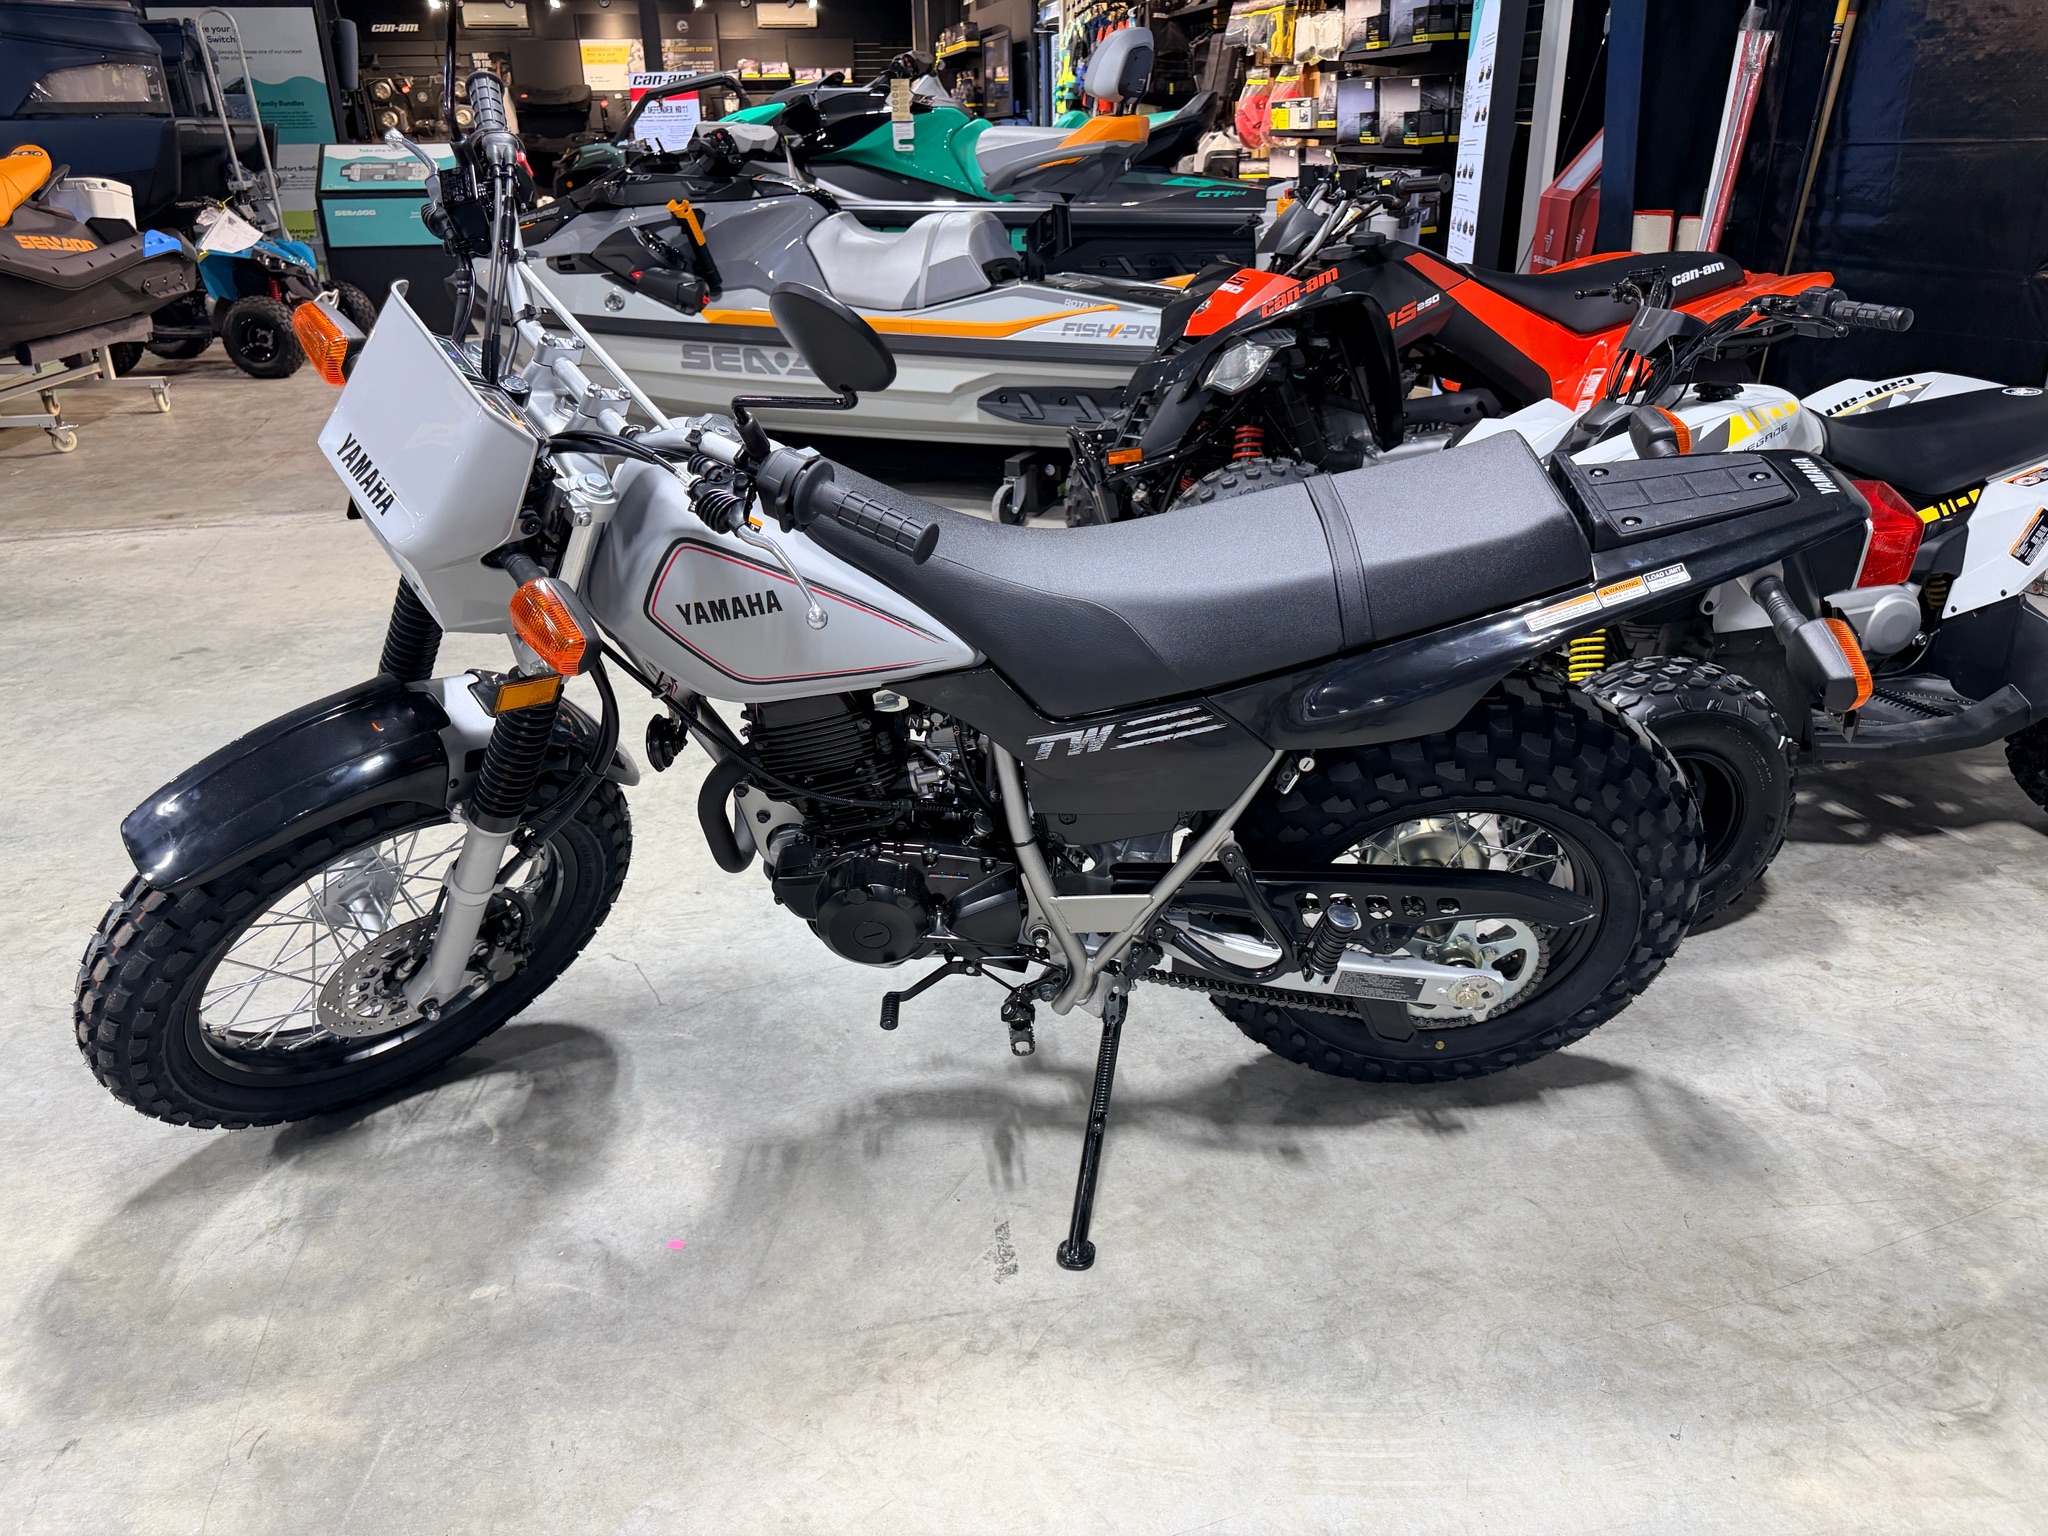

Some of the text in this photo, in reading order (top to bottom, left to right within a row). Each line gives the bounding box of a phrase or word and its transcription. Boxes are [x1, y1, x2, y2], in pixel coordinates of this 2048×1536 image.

[206, 35, 236, 44] Switch
[211, 26, 231, 35] your
[371, 23, 419, 33] can-am
[1671, 261, 1725, 287] can-am
[1261, 267, 1339, 319] can-am
[1416, 293, 1440, 312] 250
[1743, 421, 1789, 452] EGADE
[336, 431, 398, 517] YAMAHA
[1790, 457, 1840, 495] YAMAHA
[1646, 571, 1665, 581] LOAD
[1665, 566, 1682, 576] LIMIT
[1608, 580, 1639, 594] WARNING
[675, 589, 783, 625] YAMAHA
[1026, 723, 1116, 761] TW
